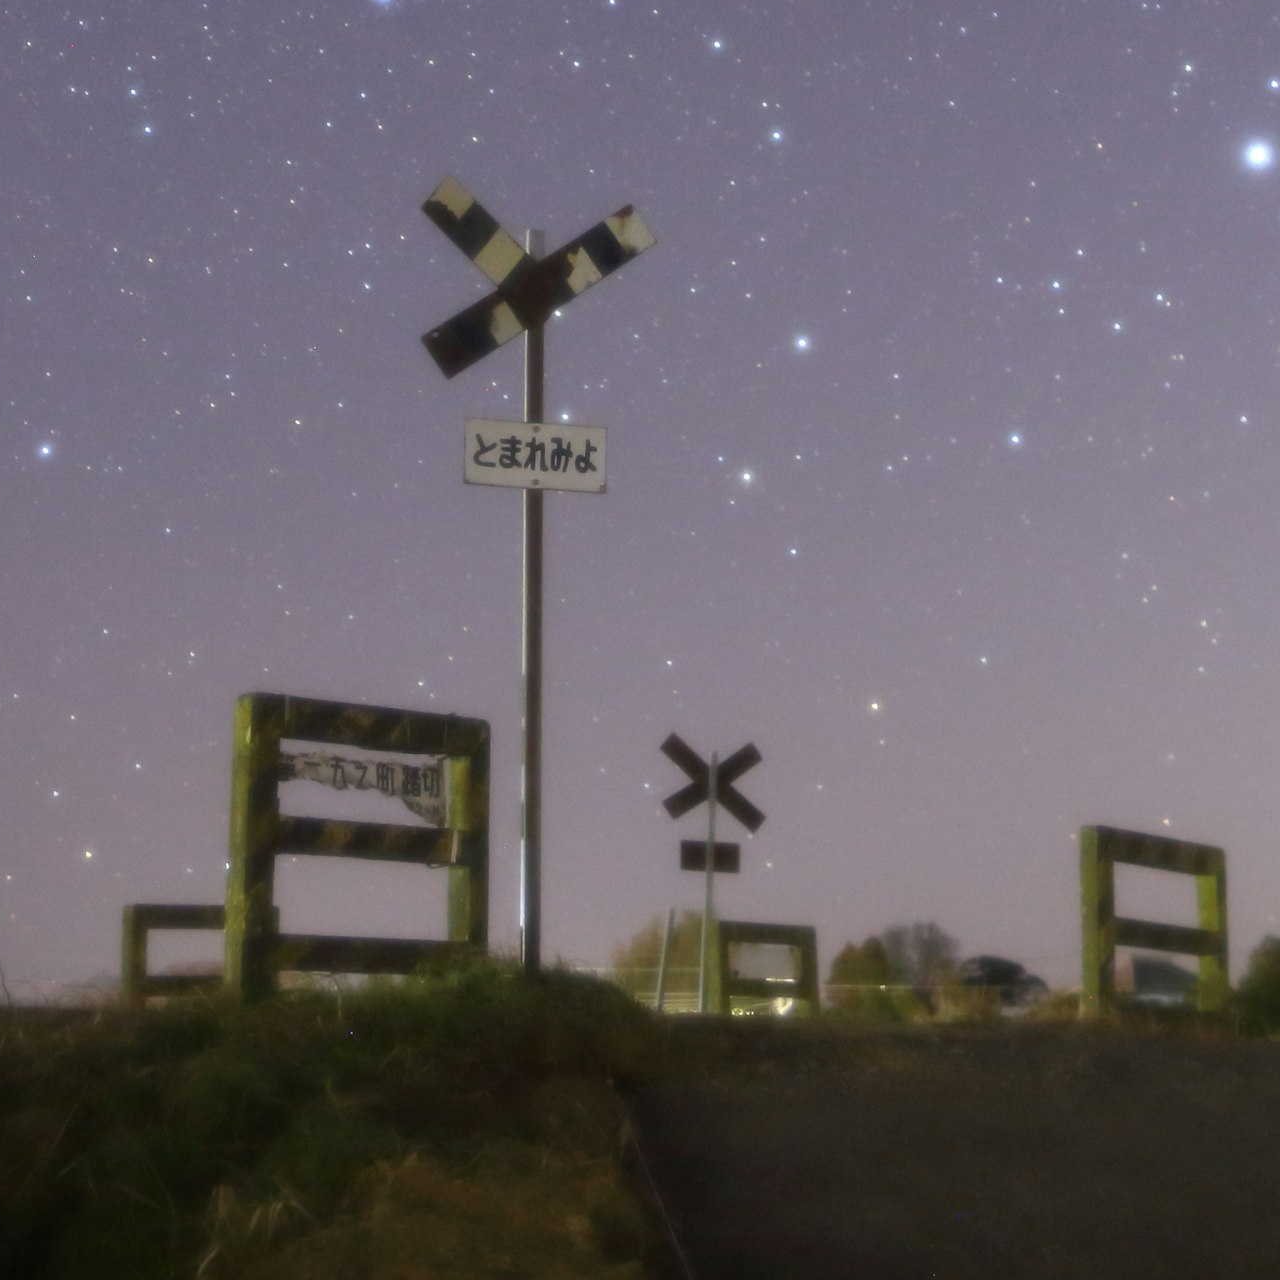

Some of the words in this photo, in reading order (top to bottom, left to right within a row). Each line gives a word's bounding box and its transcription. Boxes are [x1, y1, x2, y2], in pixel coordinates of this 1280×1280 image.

[473, 433, 598, 474] とまれみよ
